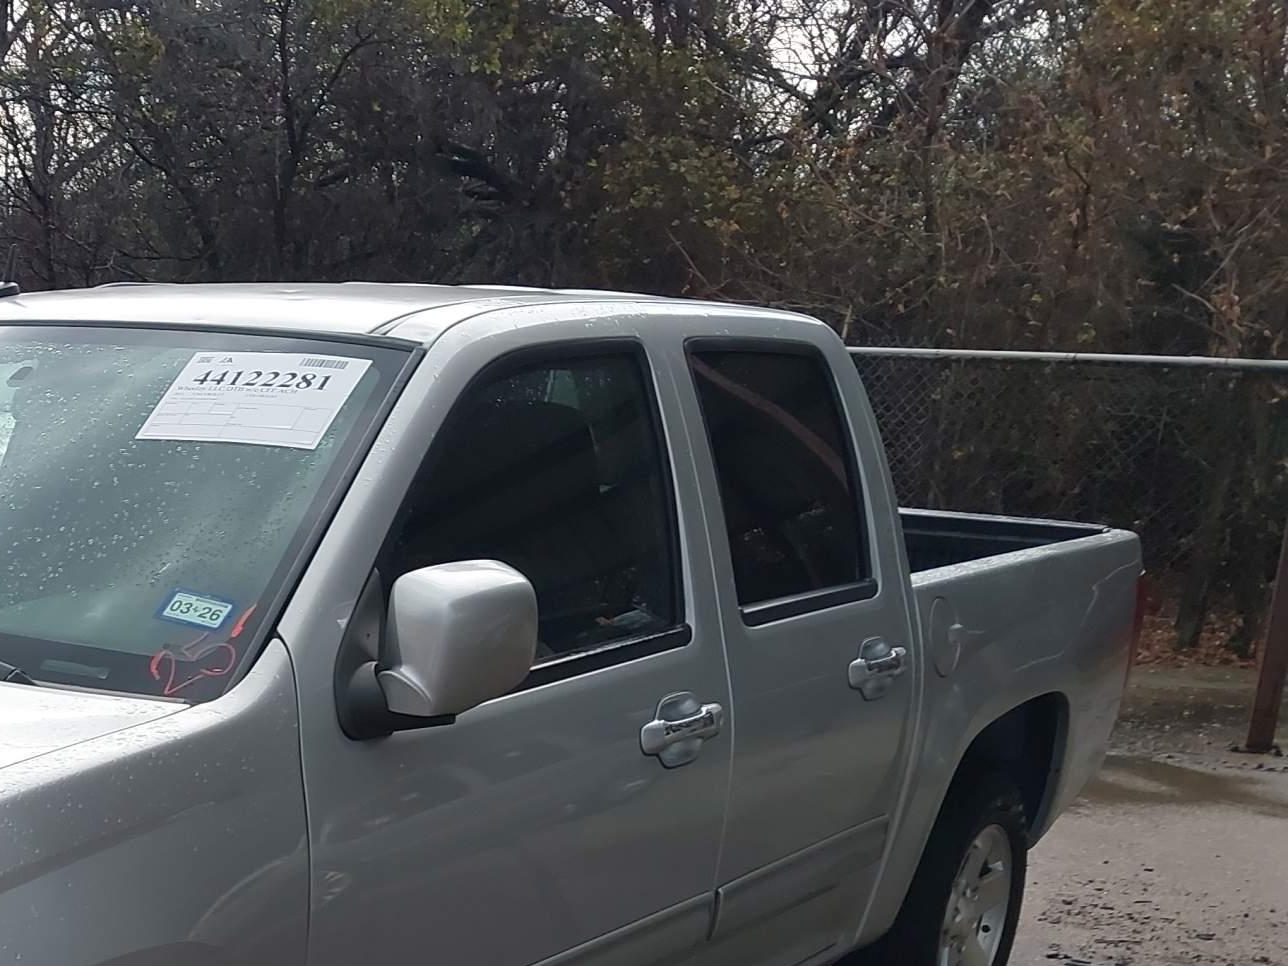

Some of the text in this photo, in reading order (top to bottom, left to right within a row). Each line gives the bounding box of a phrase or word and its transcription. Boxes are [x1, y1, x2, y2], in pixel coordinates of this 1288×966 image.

[192, 369, 332, 391] 44122281
[169, 600, 193, 614] 03
[198, 606, 223, 621] 26
